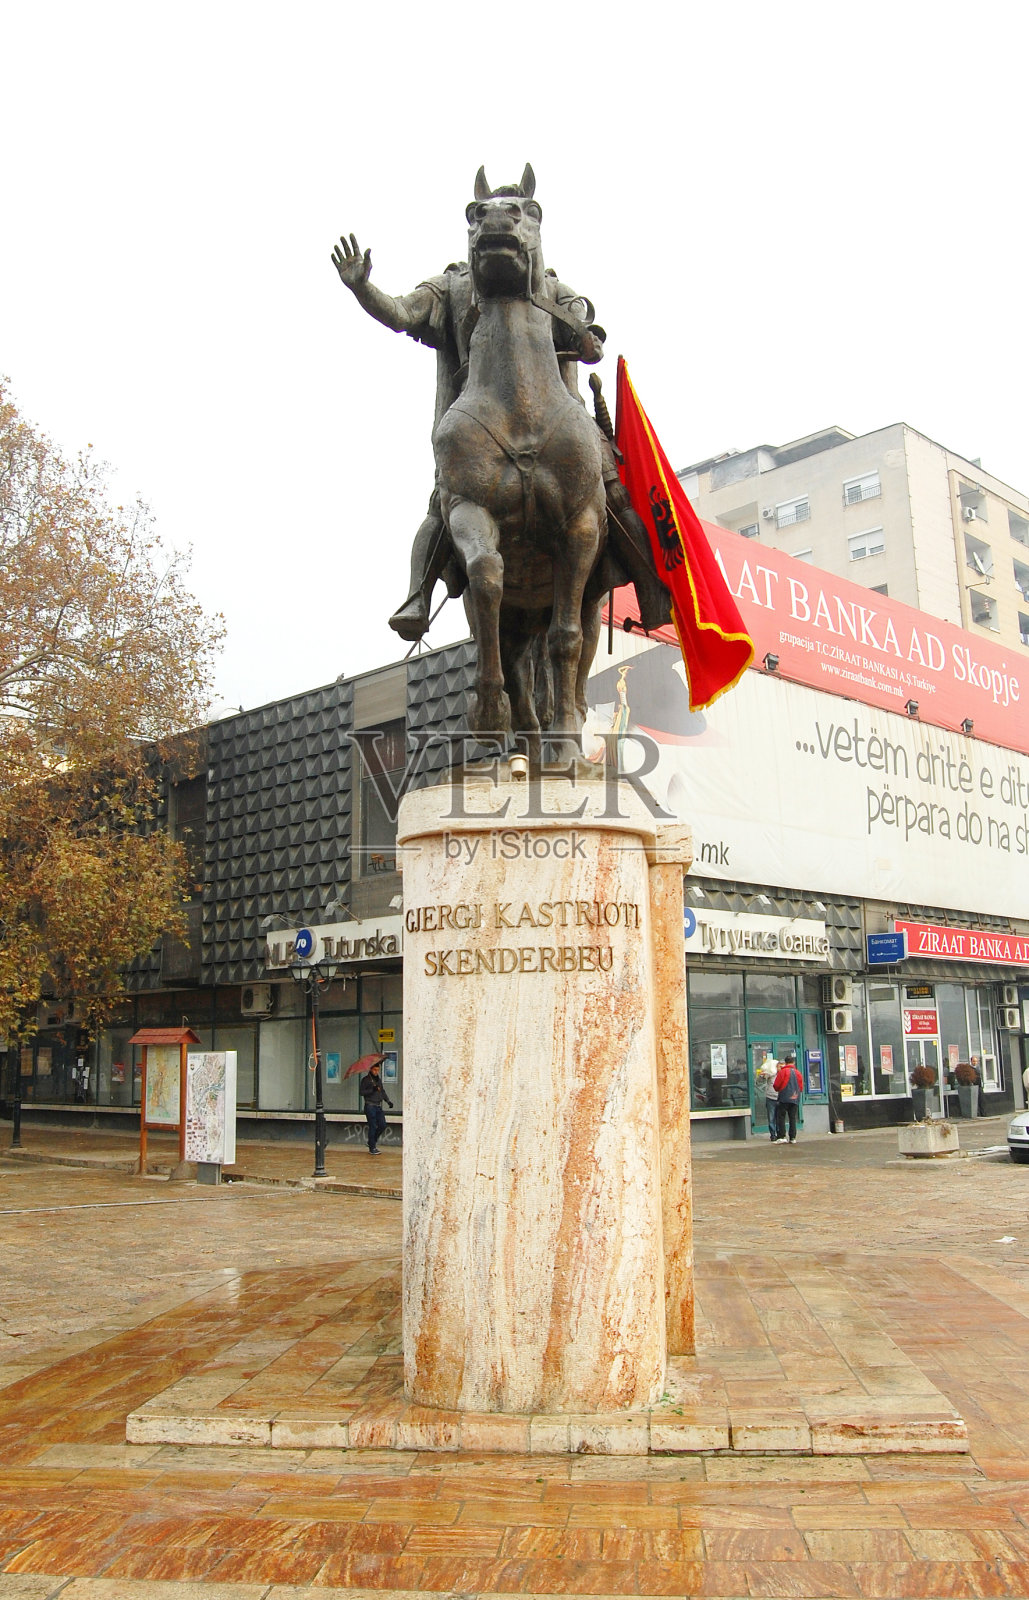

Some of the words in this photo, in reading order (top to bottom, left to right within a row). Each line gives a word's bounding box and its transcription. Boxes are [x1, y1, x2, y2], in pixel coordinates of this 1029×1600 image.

[779, 631, 815, 652] grupacija
[863, 657, 899, 679] BANKASI
[787, 577, 905, 658] BANKA
[907, 627, 945, 672] AD
[952, 644, 1020, 707] Skopje
[820, 661, 905, 697] www.ziraatbank.com.mk
[916, 741, 974, 793] dritë
[980, 767, 994, 798] e
[866, 784, 951, 842] përpara
[956, 801, 983, 845] do
[988, 816, 1010, 852] na
[405, 902, 484, 933] GJERGJ
[494, 900, 642, 929] KASTRIOTI
[321, 928, 400, 960] Tutunska
[698, 920, 779, 955] Тутунска
[779, 925, 830, 954] банка
[969, 936, 1012, 959] BANKA
[424, 946, 614, 977] SKENDERBEU
